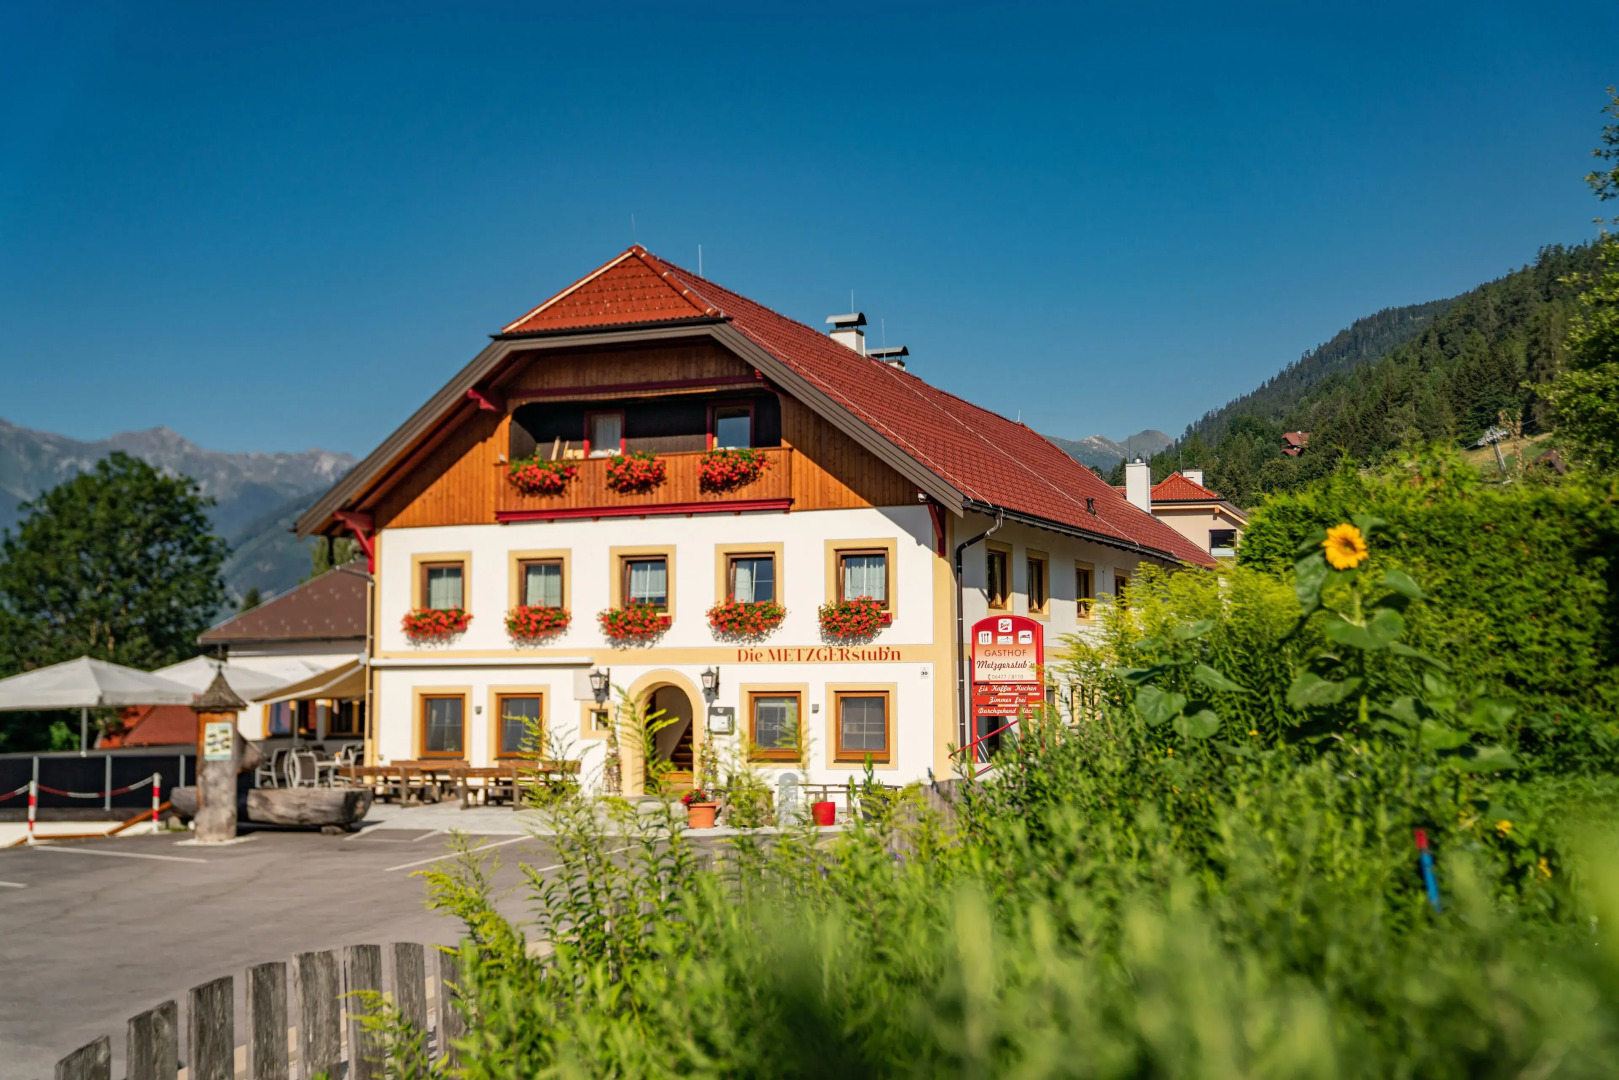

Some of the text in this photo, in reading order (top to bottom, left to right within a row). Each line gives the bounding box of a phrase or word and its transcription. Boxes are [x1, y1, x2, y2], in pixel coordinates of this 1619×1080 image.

[737, 648, 763, 662] Die
[984, 649, 1027, 657] GASTHOF
[978, 685, 988, 693] Eis
[1014, 684, 1037, 692] Kuchen
[988, 696, 1027, 704] Zimmer frei
